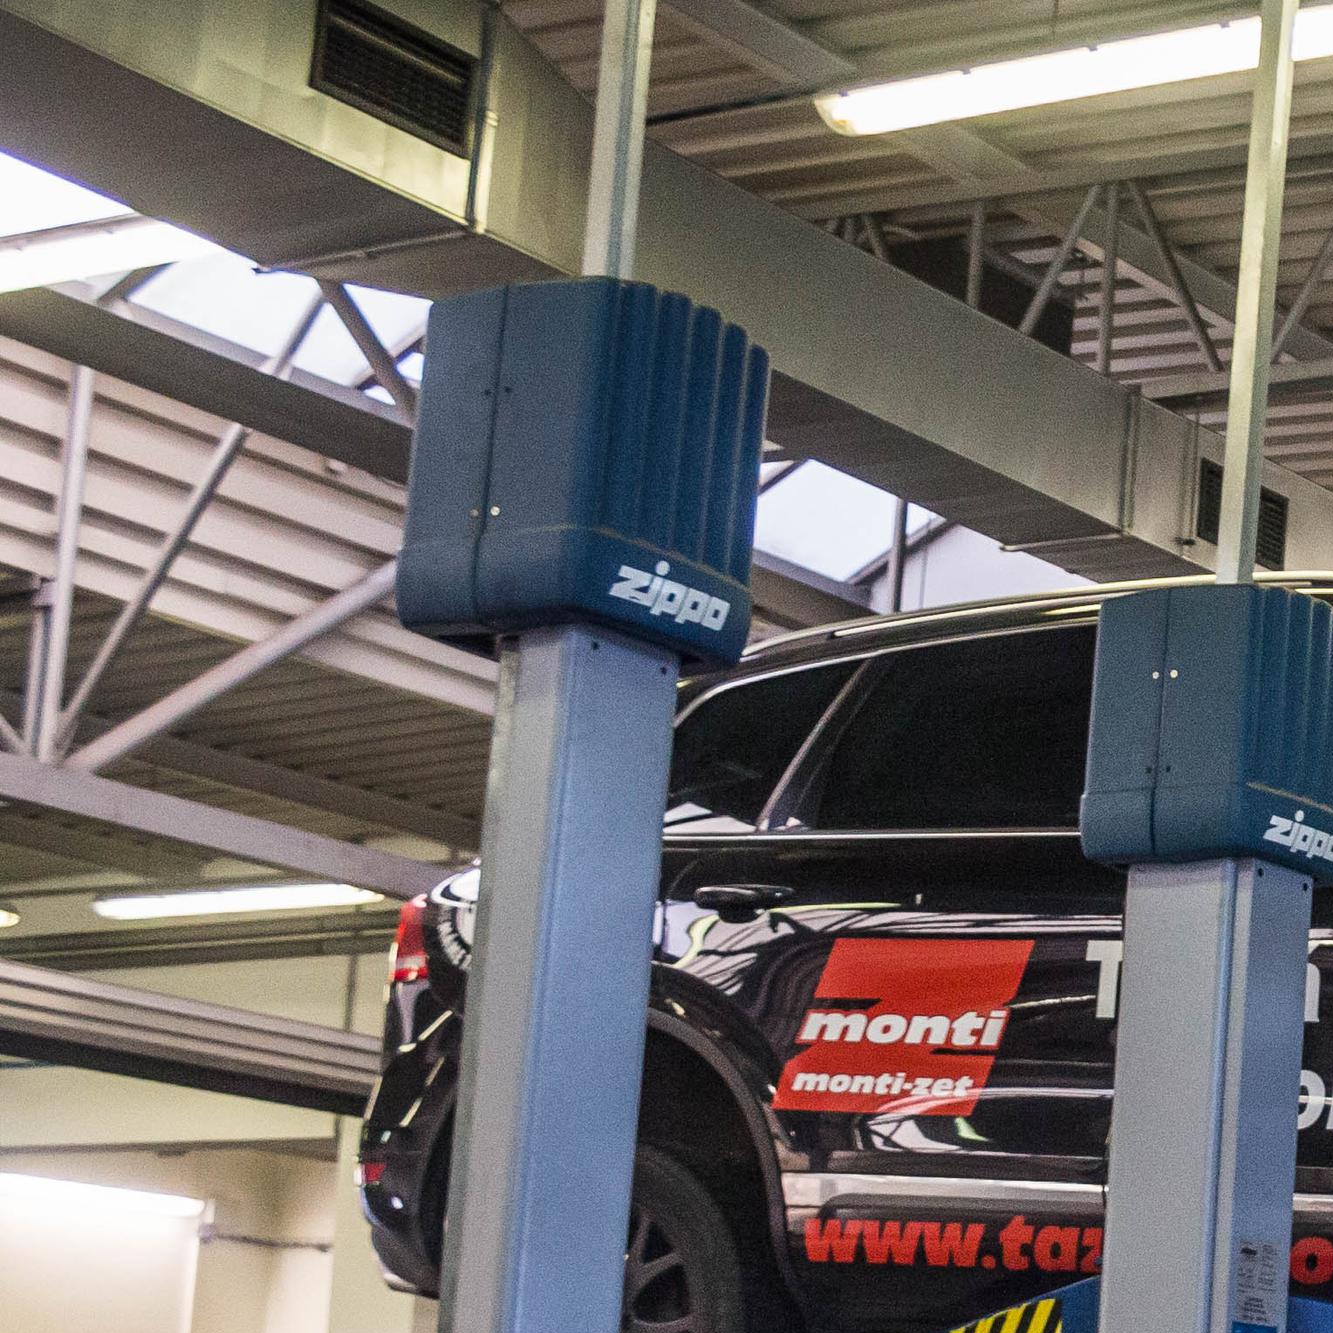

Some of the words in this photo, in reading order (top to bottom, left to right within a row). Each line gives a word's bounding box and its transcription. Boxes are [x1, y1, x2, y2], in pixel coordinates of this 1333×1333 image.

[608, 560, 732, 632] zippo
[801, 1011, 1006, 1046] monti
[791, 1072, 973, 1098] monti-zet
